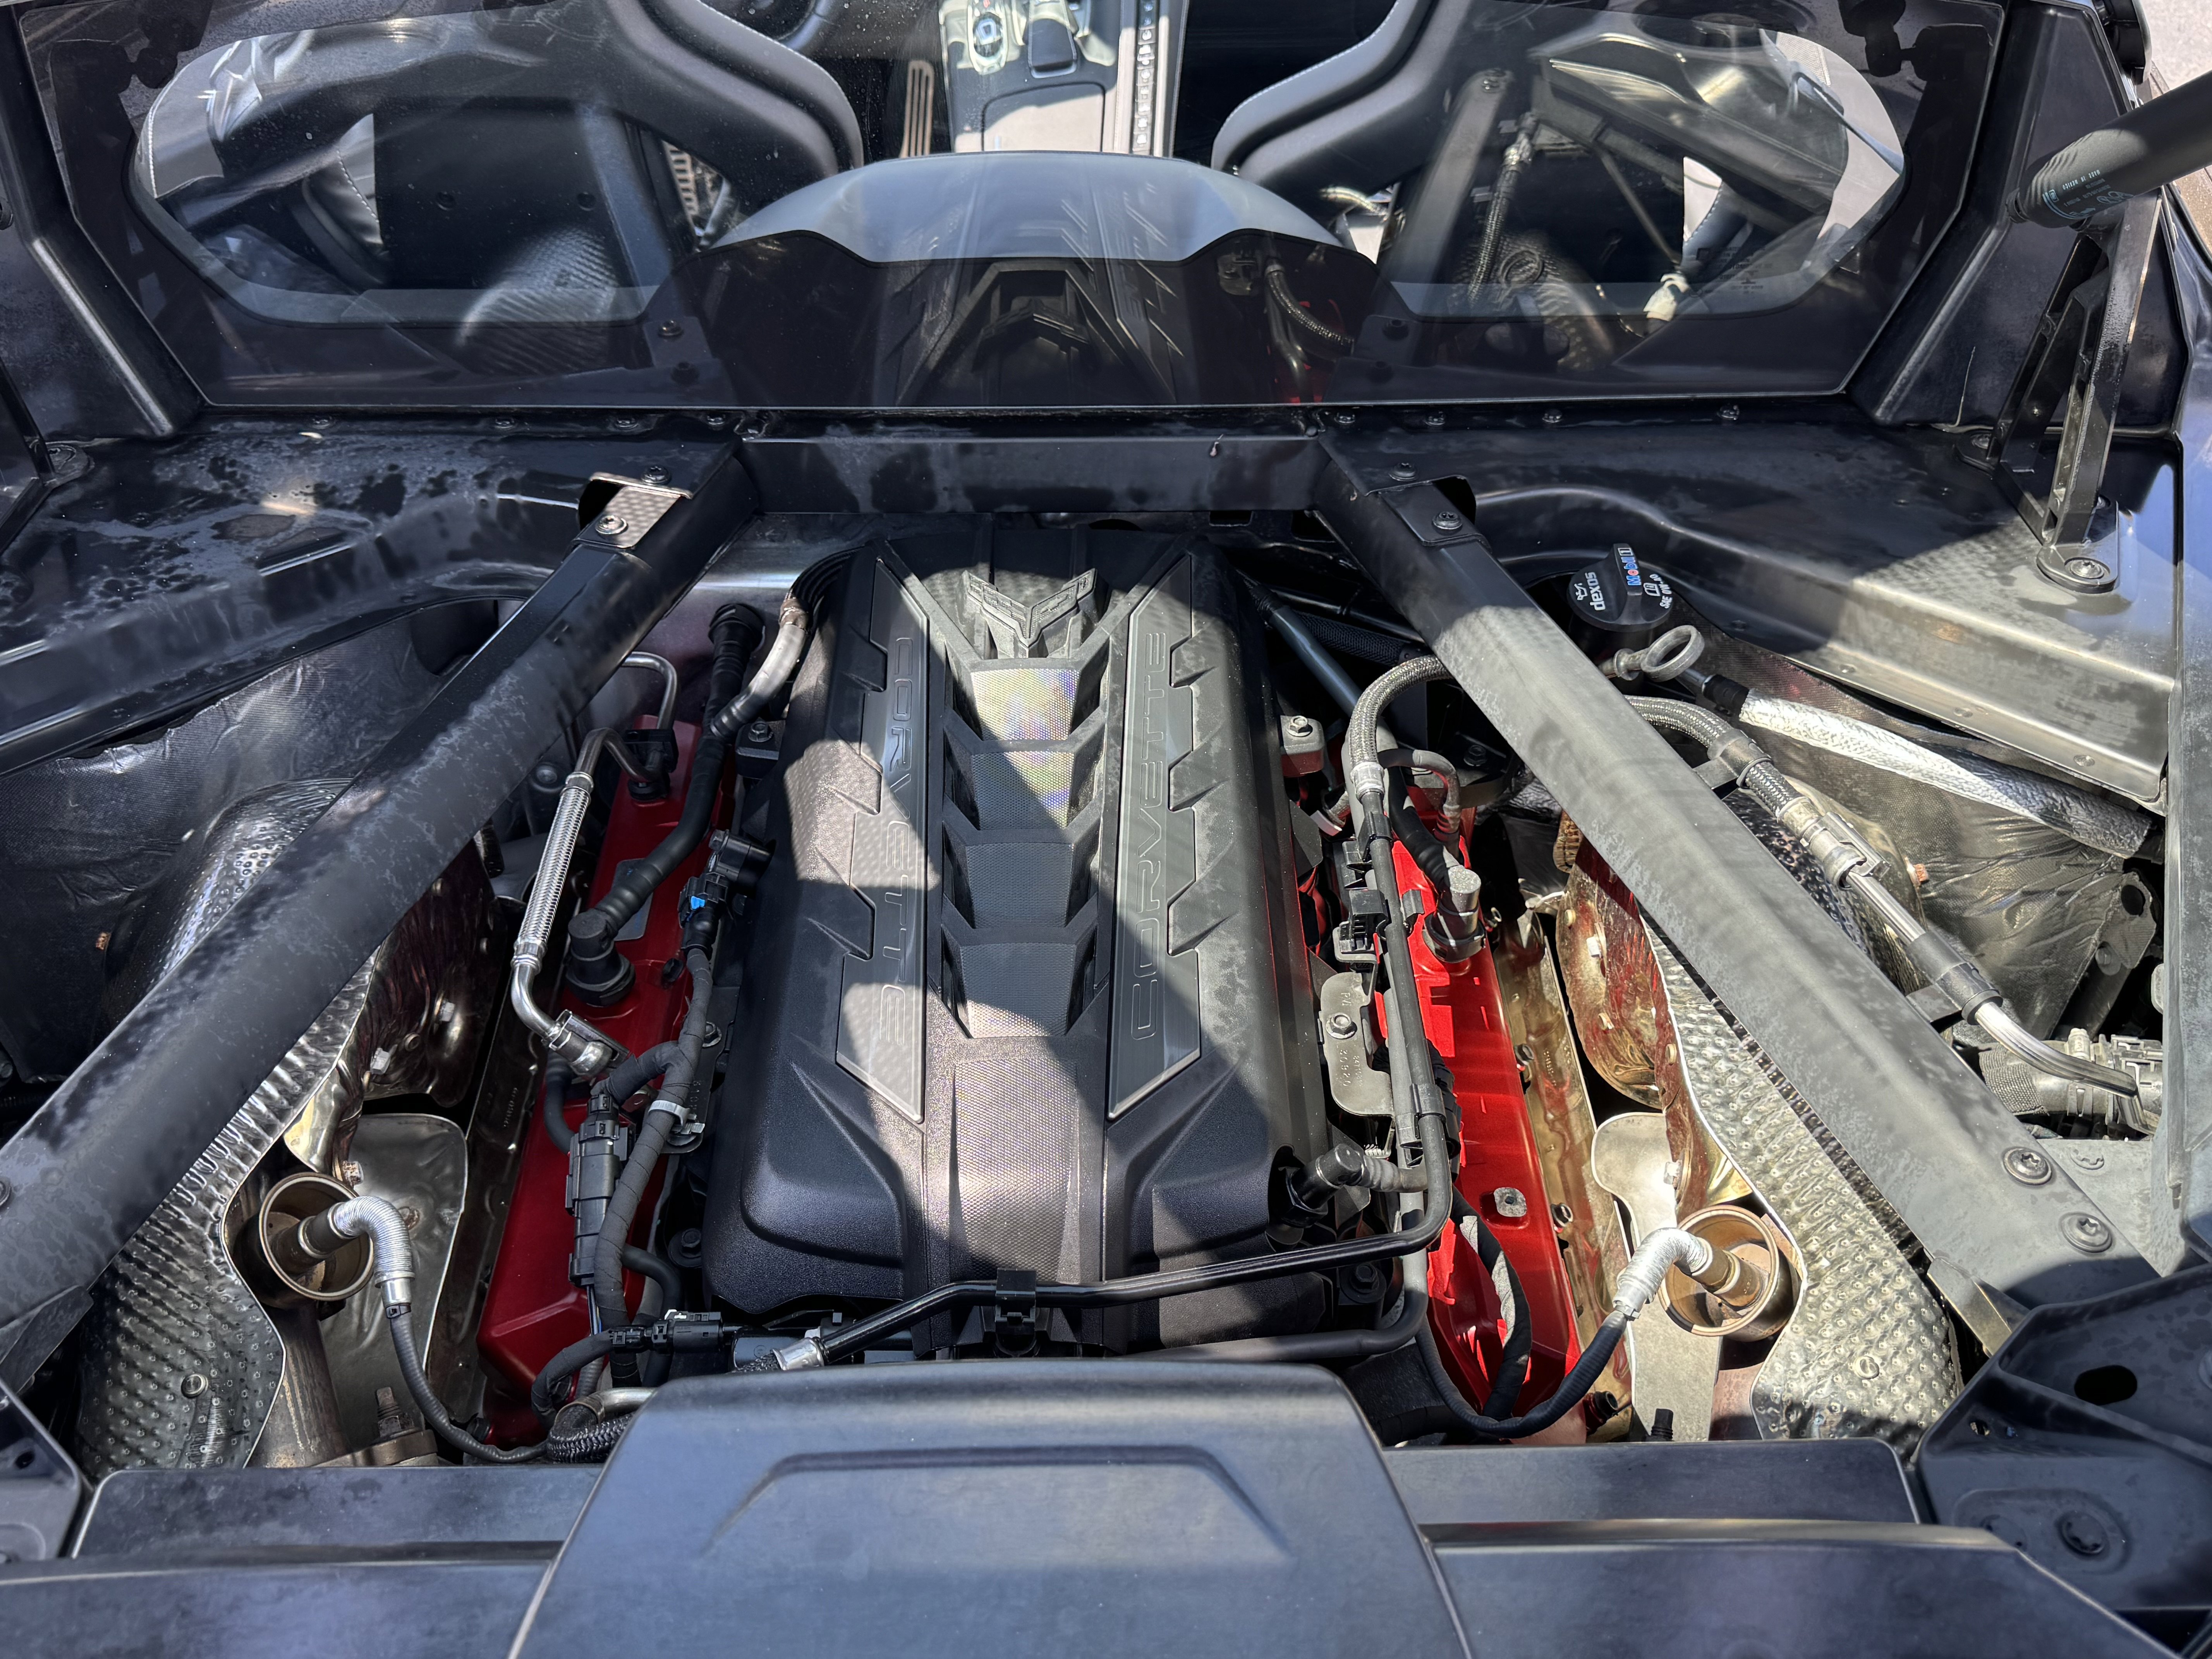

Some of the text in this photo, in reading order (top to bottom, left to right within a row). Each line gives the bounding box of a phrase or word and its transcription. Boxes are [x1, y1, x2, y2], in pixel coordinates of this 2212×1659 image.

[2063, 179, 2078, 190] MEXICO
[1621, 556, 1642, 586] Mobil
[1585, 572, 1606, 611] dexos
[1659, 596, 1673, 609] SAE
[880, 637, 913, 1045] CORVETTE
[1131, 632, 1166, 1040] CORVETTE
